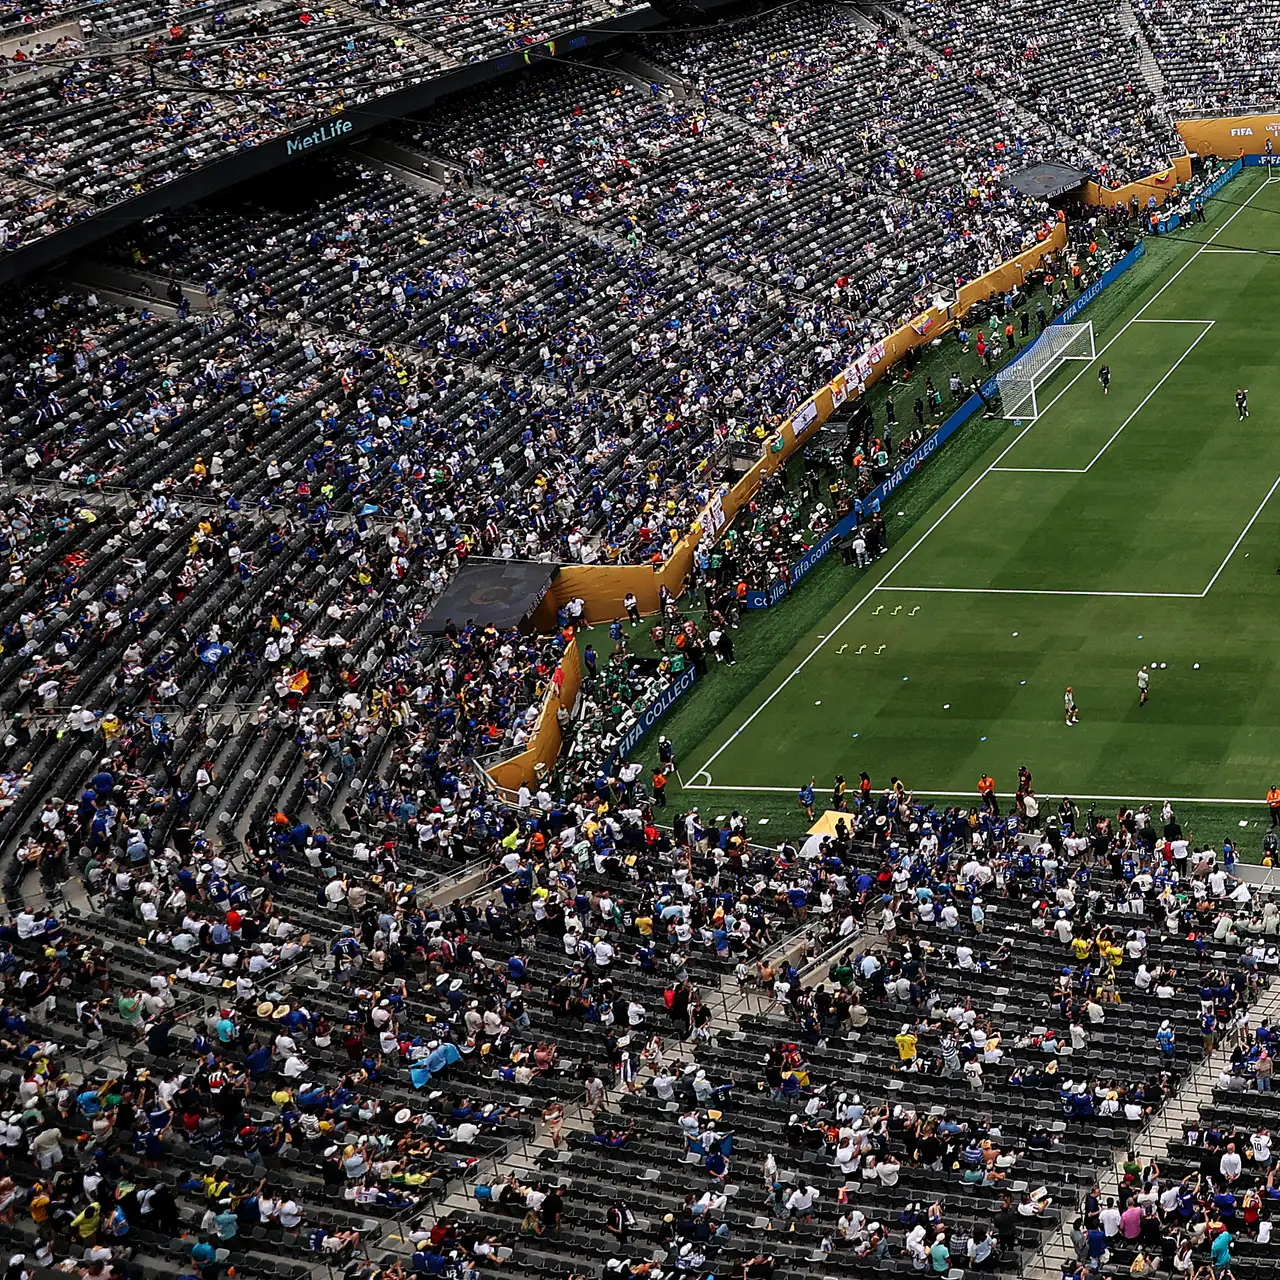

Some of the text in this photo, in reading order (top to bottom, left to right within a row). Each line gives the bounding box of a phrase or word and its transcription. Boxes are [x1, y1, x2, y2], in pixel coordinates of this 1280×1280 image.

[286, 119, 353, 155] MetLife
[1230, 127, 1254, 137] FIFA
[1212, 168, 1233, 192] COLLECT
[1062, 280, 1104, 324] FIFA COLLECT
[882, 433, 940, 496] FIFA COLLECT
[618, 666, 696, 758] FIFA COLLECT
[1253, 1142, 1262, 1152] 10
